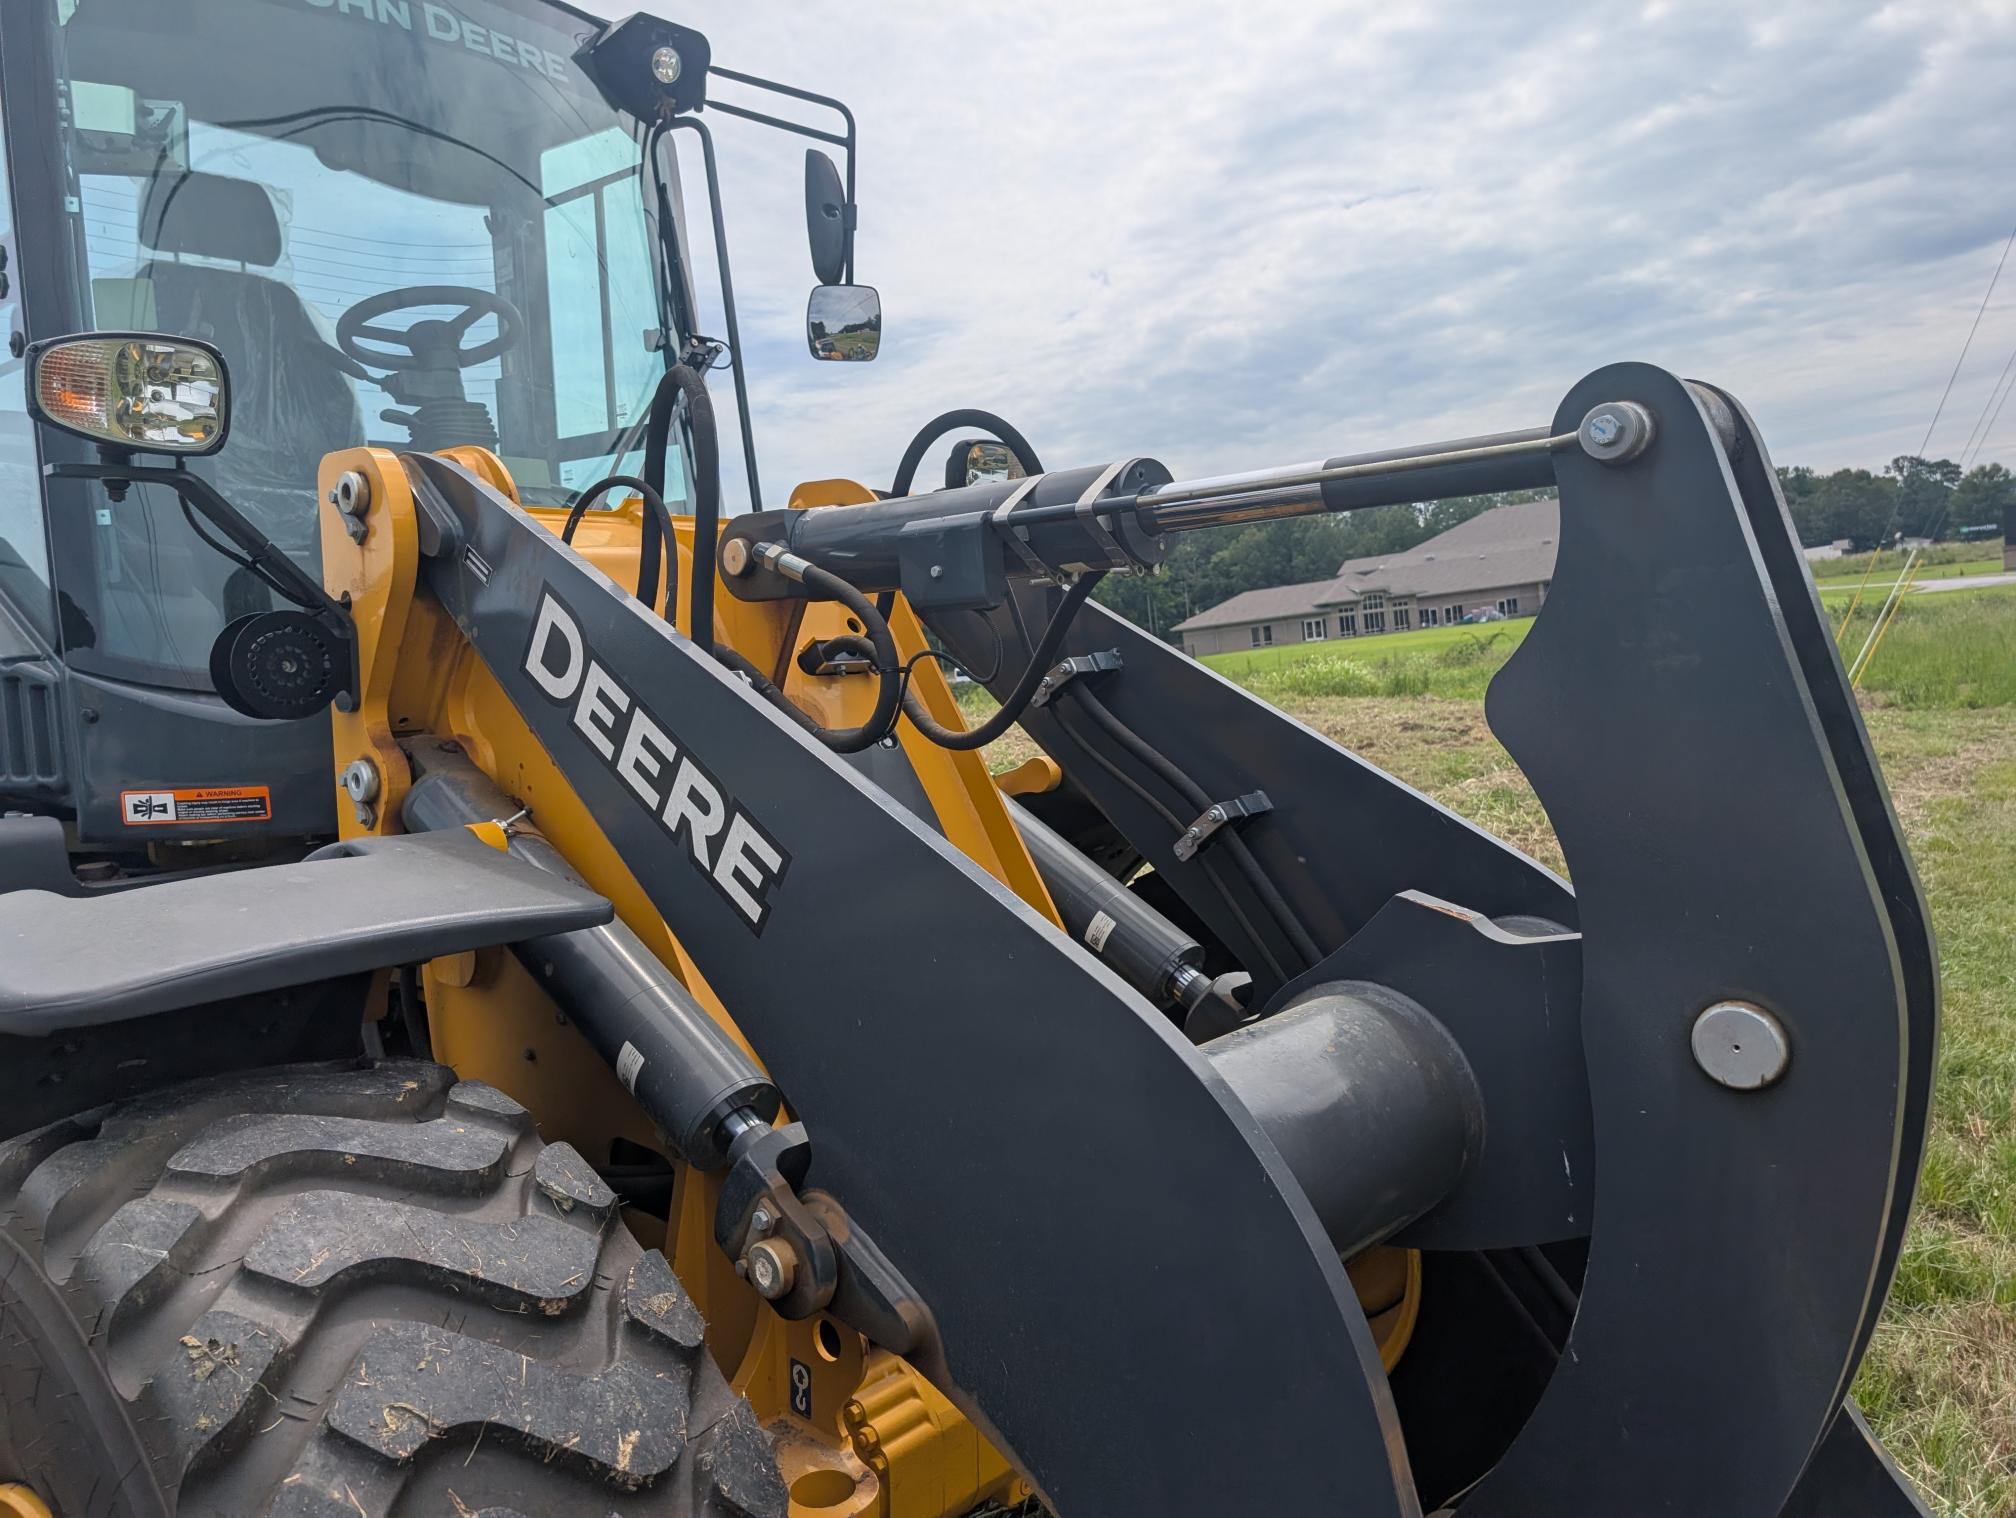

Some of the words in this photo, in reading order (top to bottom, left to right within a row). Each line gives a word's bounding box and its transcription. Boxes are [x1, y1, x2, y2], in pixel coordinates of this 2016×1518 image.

[304, 0, 412, 31] HN
[423, 2, 570, 83] DEERE
[206, 790, 242, 798] WARNING
[525, 592, 783, 924] DEERE
